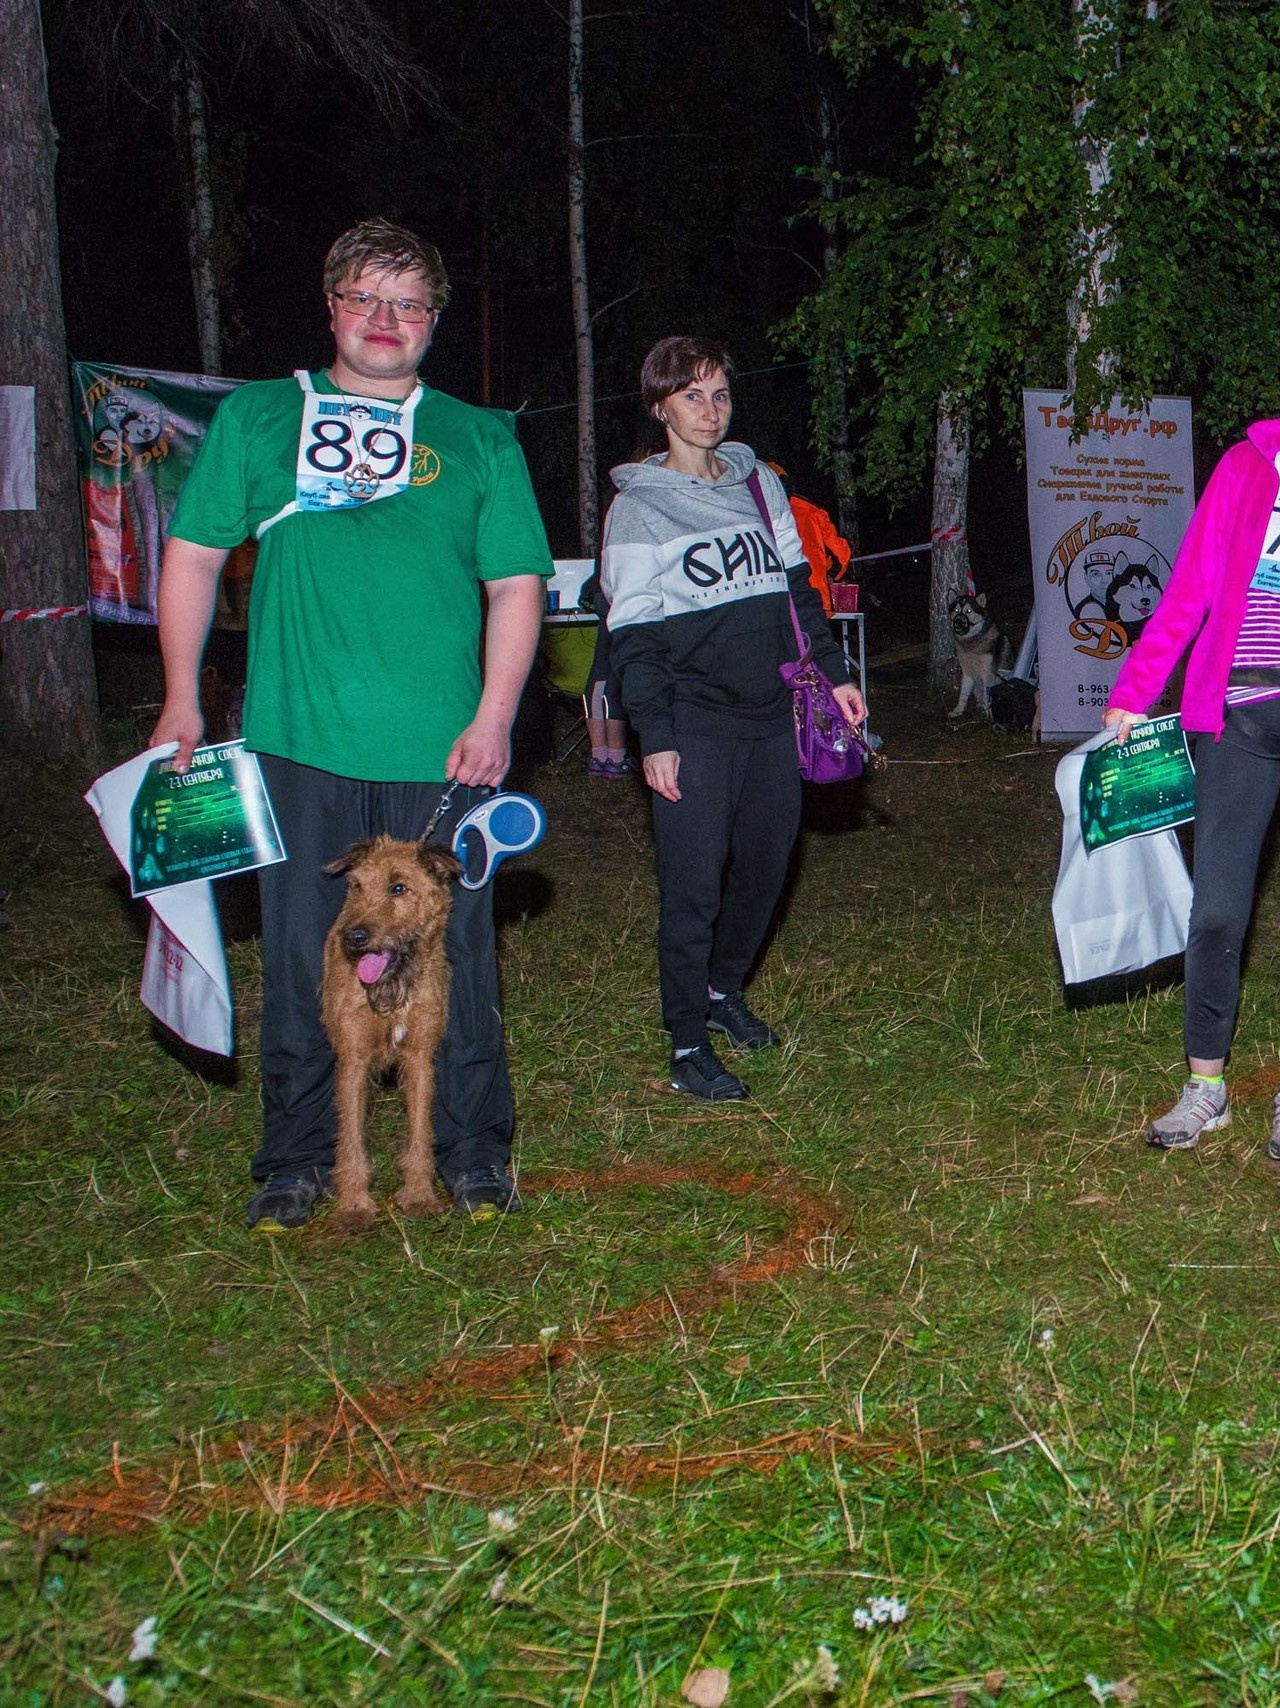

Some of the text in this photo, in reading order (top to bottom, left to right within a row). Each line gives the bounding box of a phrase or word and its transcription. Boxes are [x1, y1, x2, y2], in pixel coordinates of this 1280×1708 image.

[317, 401, 403, 425] HEY HEY
[305, 420, 407, 480] 89
[1046, 511, 1141, 586] Твой
[181, 767, 224, 787] СЕНТЯБРЯ
